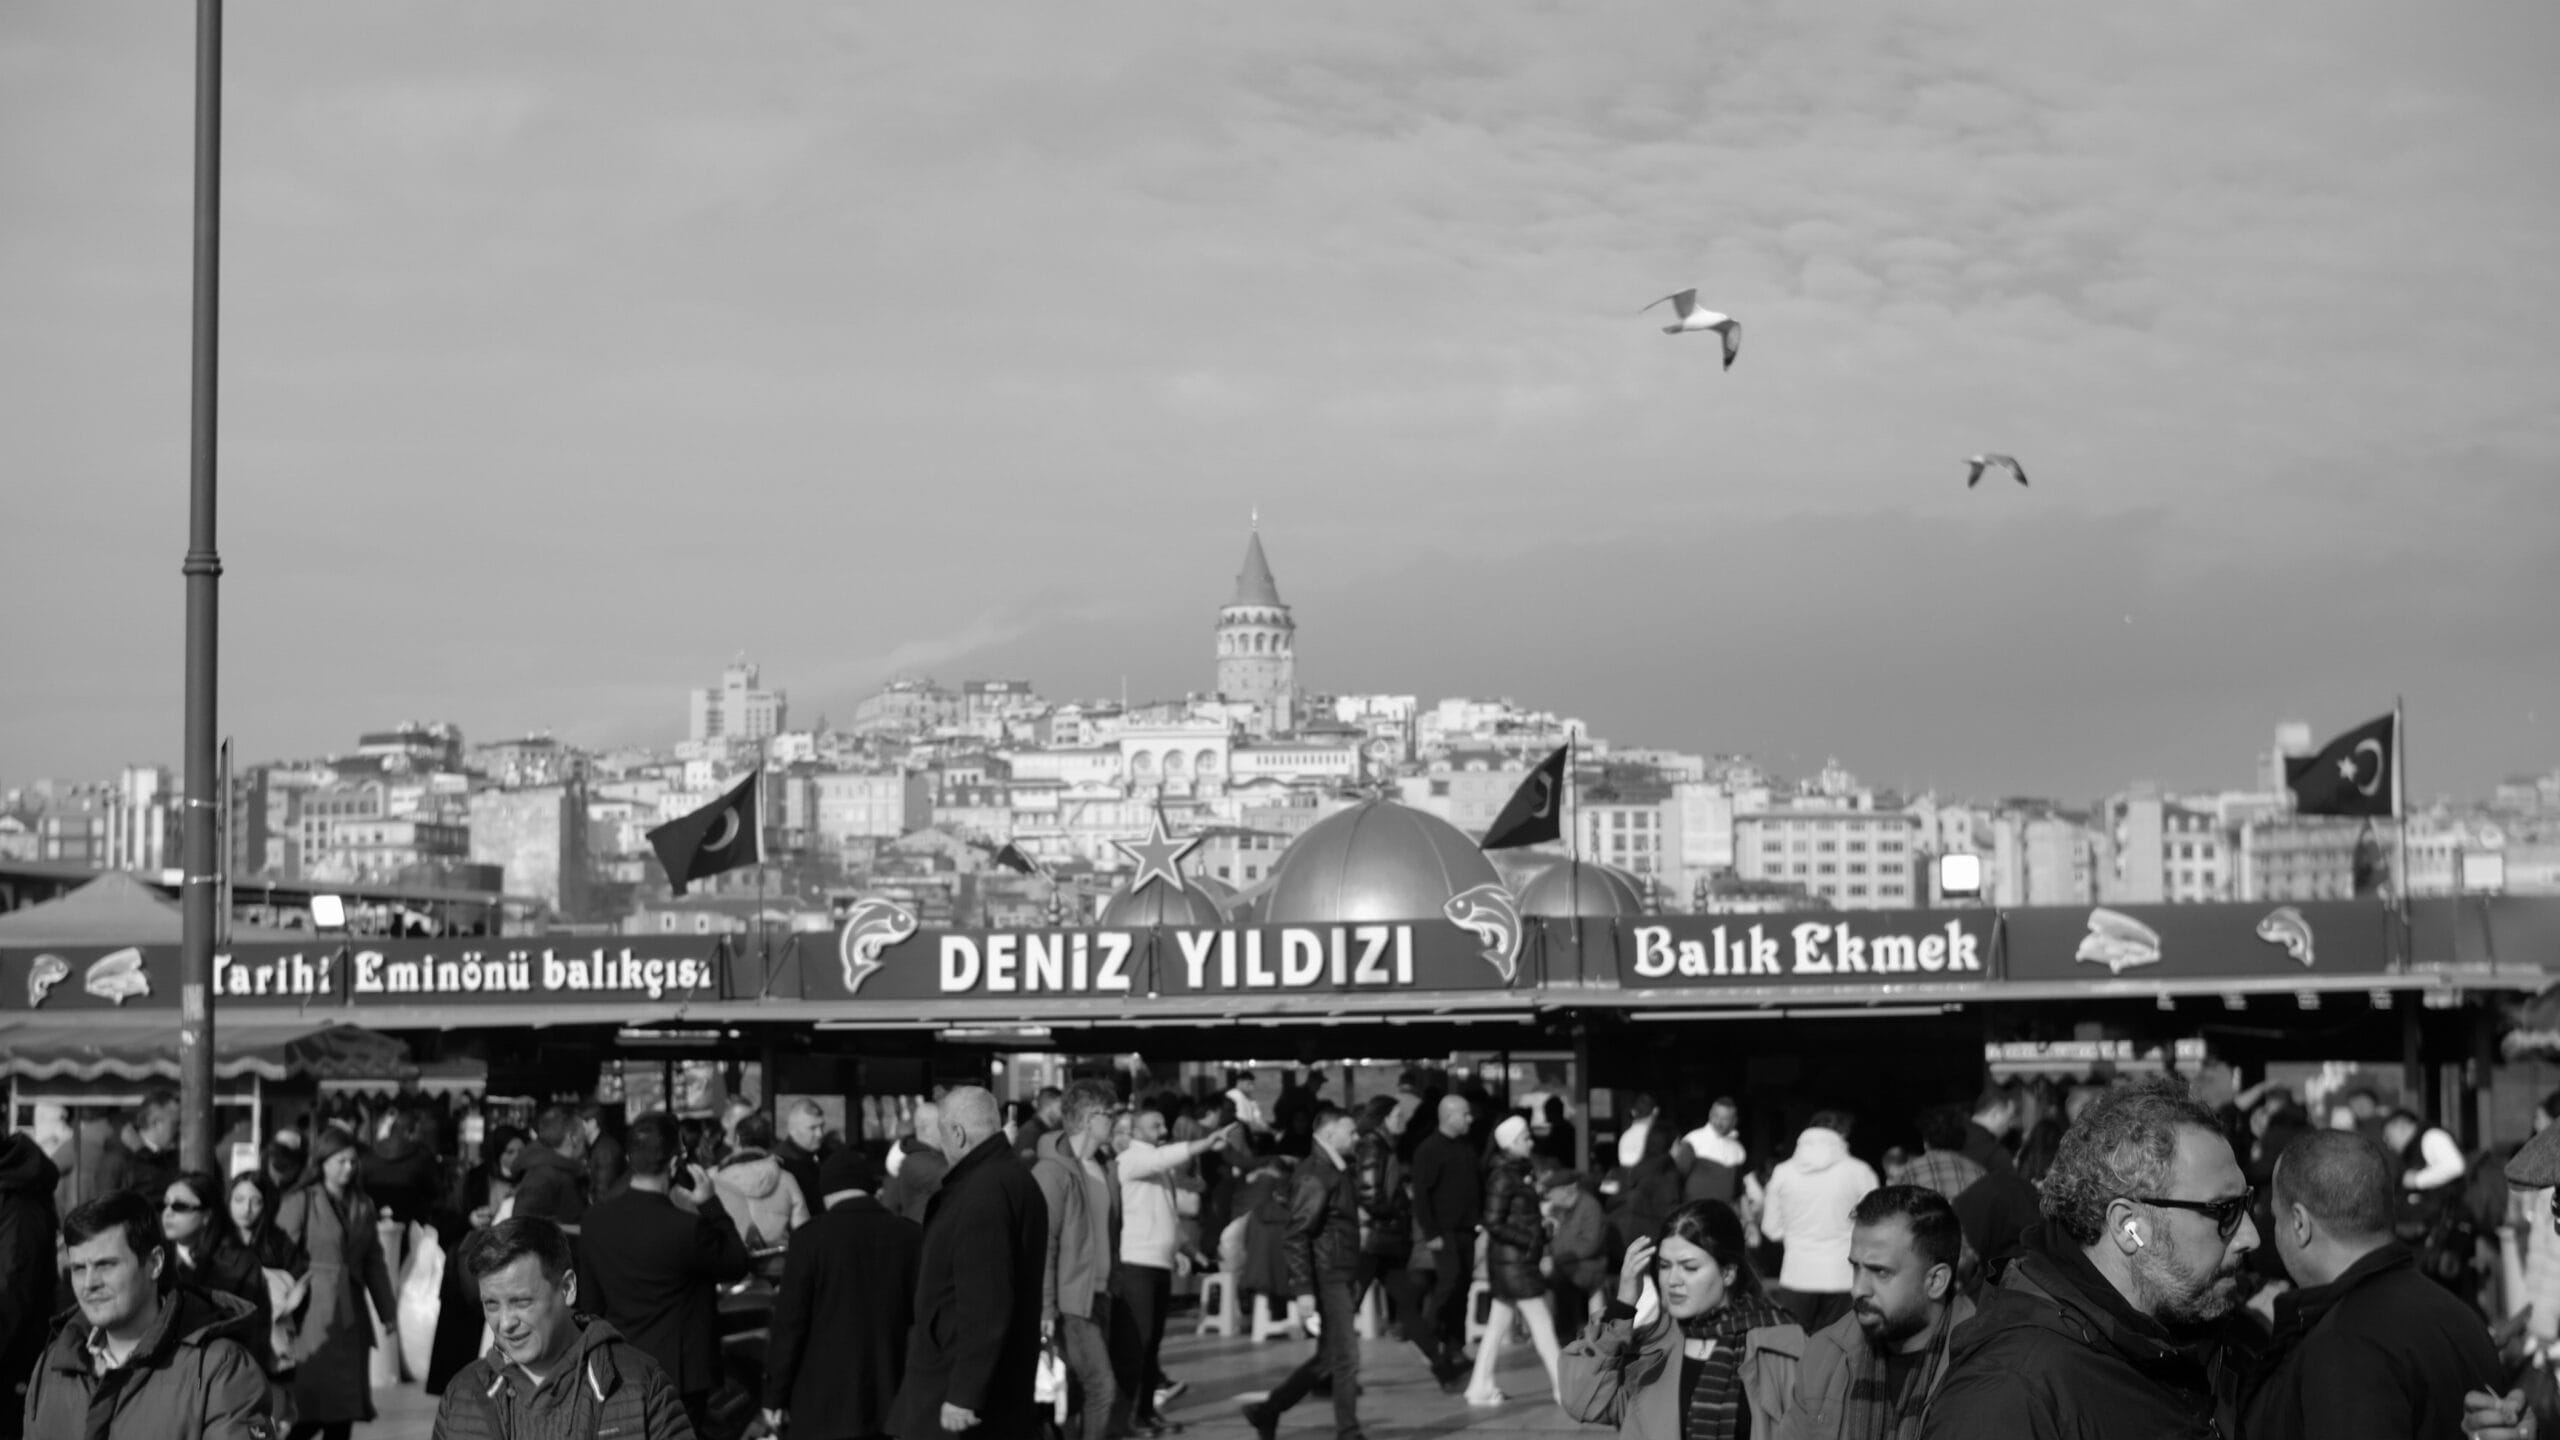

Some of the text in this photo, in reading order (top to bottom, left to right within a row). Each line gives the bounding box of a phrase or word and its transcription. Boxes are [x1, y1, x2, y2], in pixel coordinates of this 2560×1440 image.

[213, 952, 331, 995] Tarihi
[354, 950, 530, 992] Eminönü
[1176, 924, 1414, 987] YILDIZI
[1633, 918, 1981, 977] Balık Ekmek
